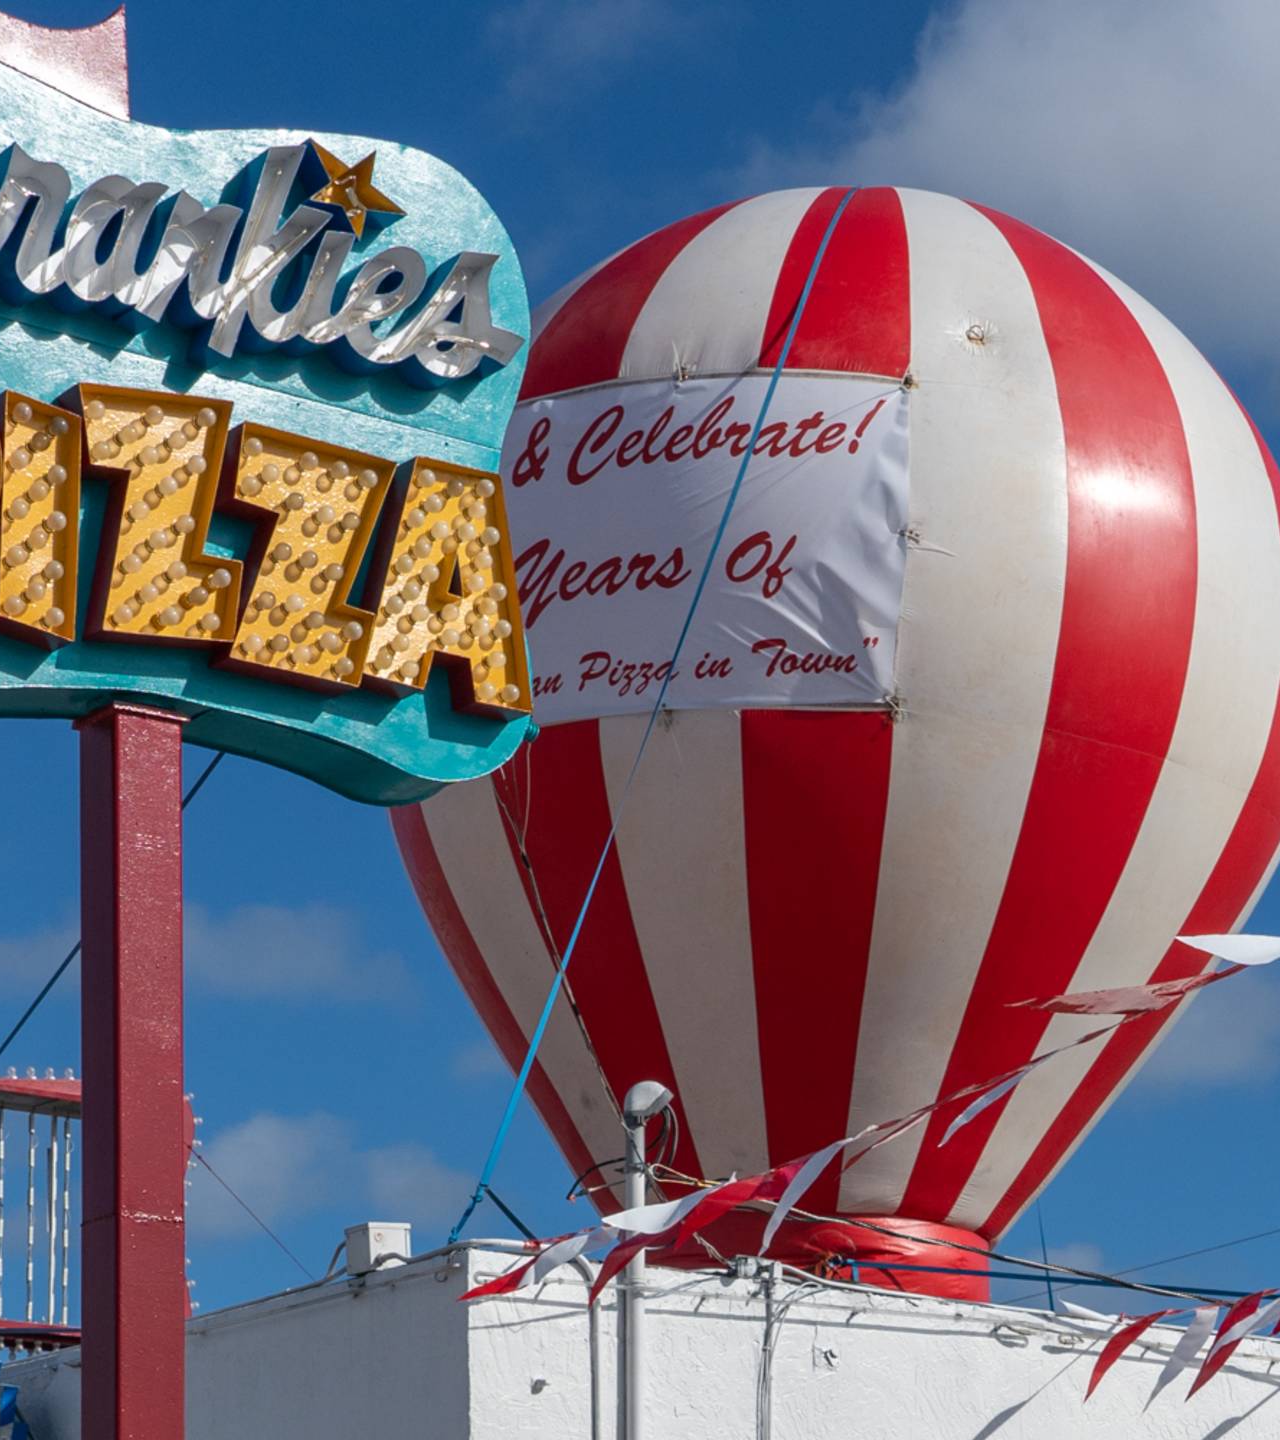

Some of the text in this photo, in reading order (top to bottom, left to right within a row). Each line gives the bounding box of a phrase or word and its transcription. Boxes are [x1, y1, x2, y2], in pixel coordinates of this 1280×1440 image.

[512, 395, 887, 488] & Celebrate!
[515, 531, 798, 629] Years Of
[578, 651, 679, 697] Pizza
[694, 652, 733, 679] in
[751, 637, 880, 677] Town"
